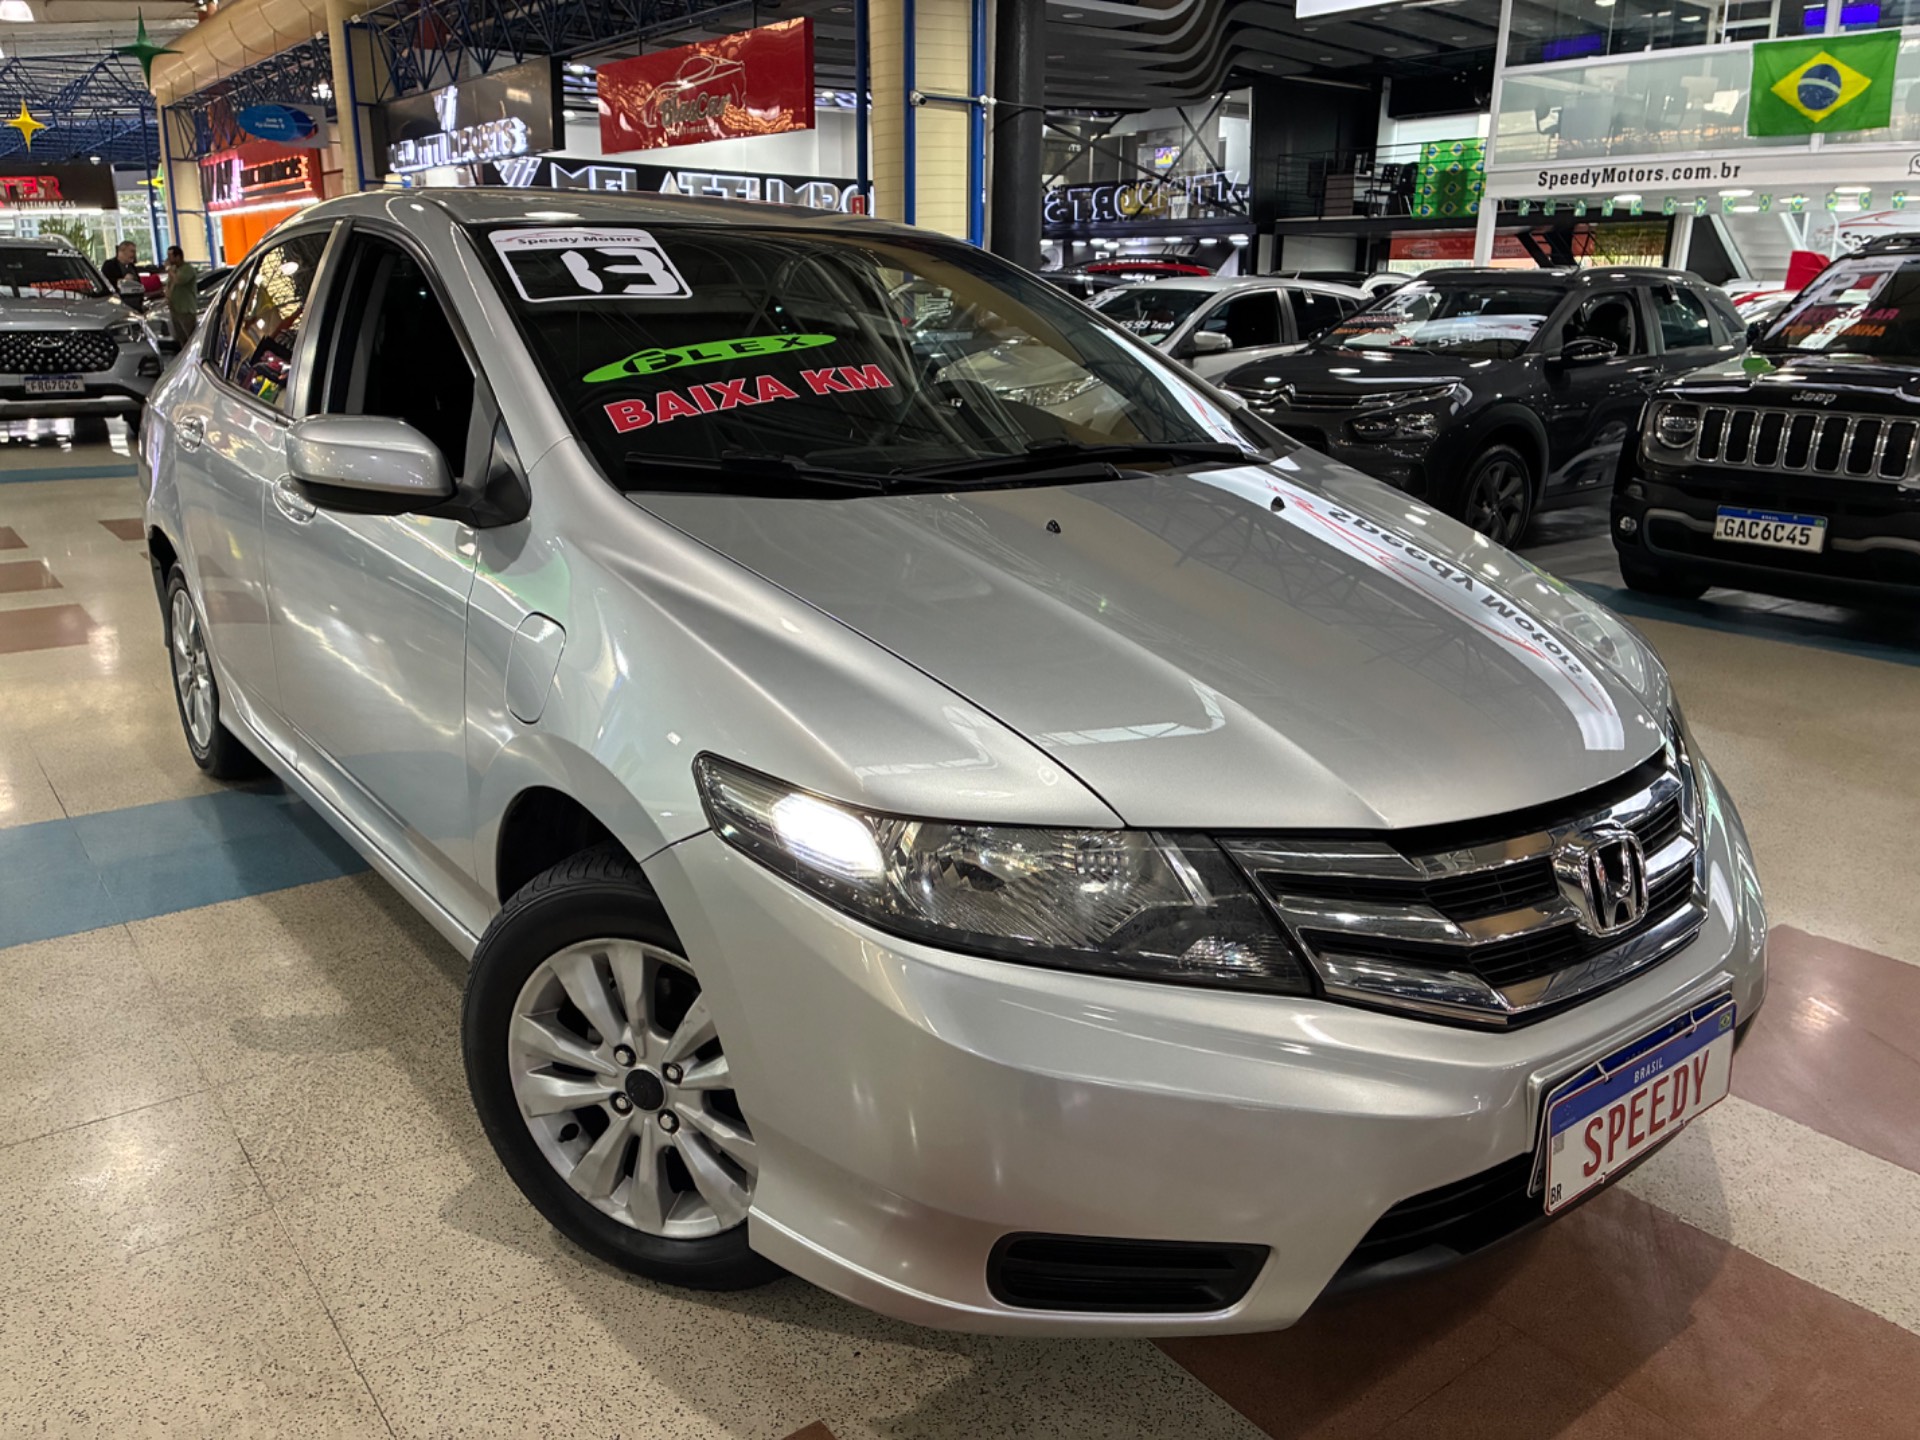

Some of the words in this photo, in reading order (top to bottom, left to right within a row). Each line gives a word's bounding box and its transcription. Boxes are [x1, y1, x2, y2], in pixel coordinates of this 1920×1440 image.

[1537, 162, 1741, 190] SpeedyMotors.com.br
[10, 200, 77, 209] MULTIMARCAS
[518, 236, 579, 245] Speedy
[583, 235, 641, 243] Motors
[631, 336, 811, 374] FLEX
[603, 374, 800, 433] BAIXA
[800, 363, 894, 395] KM
[1791, 389, 1837, 405] Jeep
[1723, 518, 1812, 546] GAC6C45
[1634, 1057, 1664, 1084] BRASIL
[1583, 1049, 1710, 1177] SPEEDY
[1550, 1183, 1562, 1206] BR
